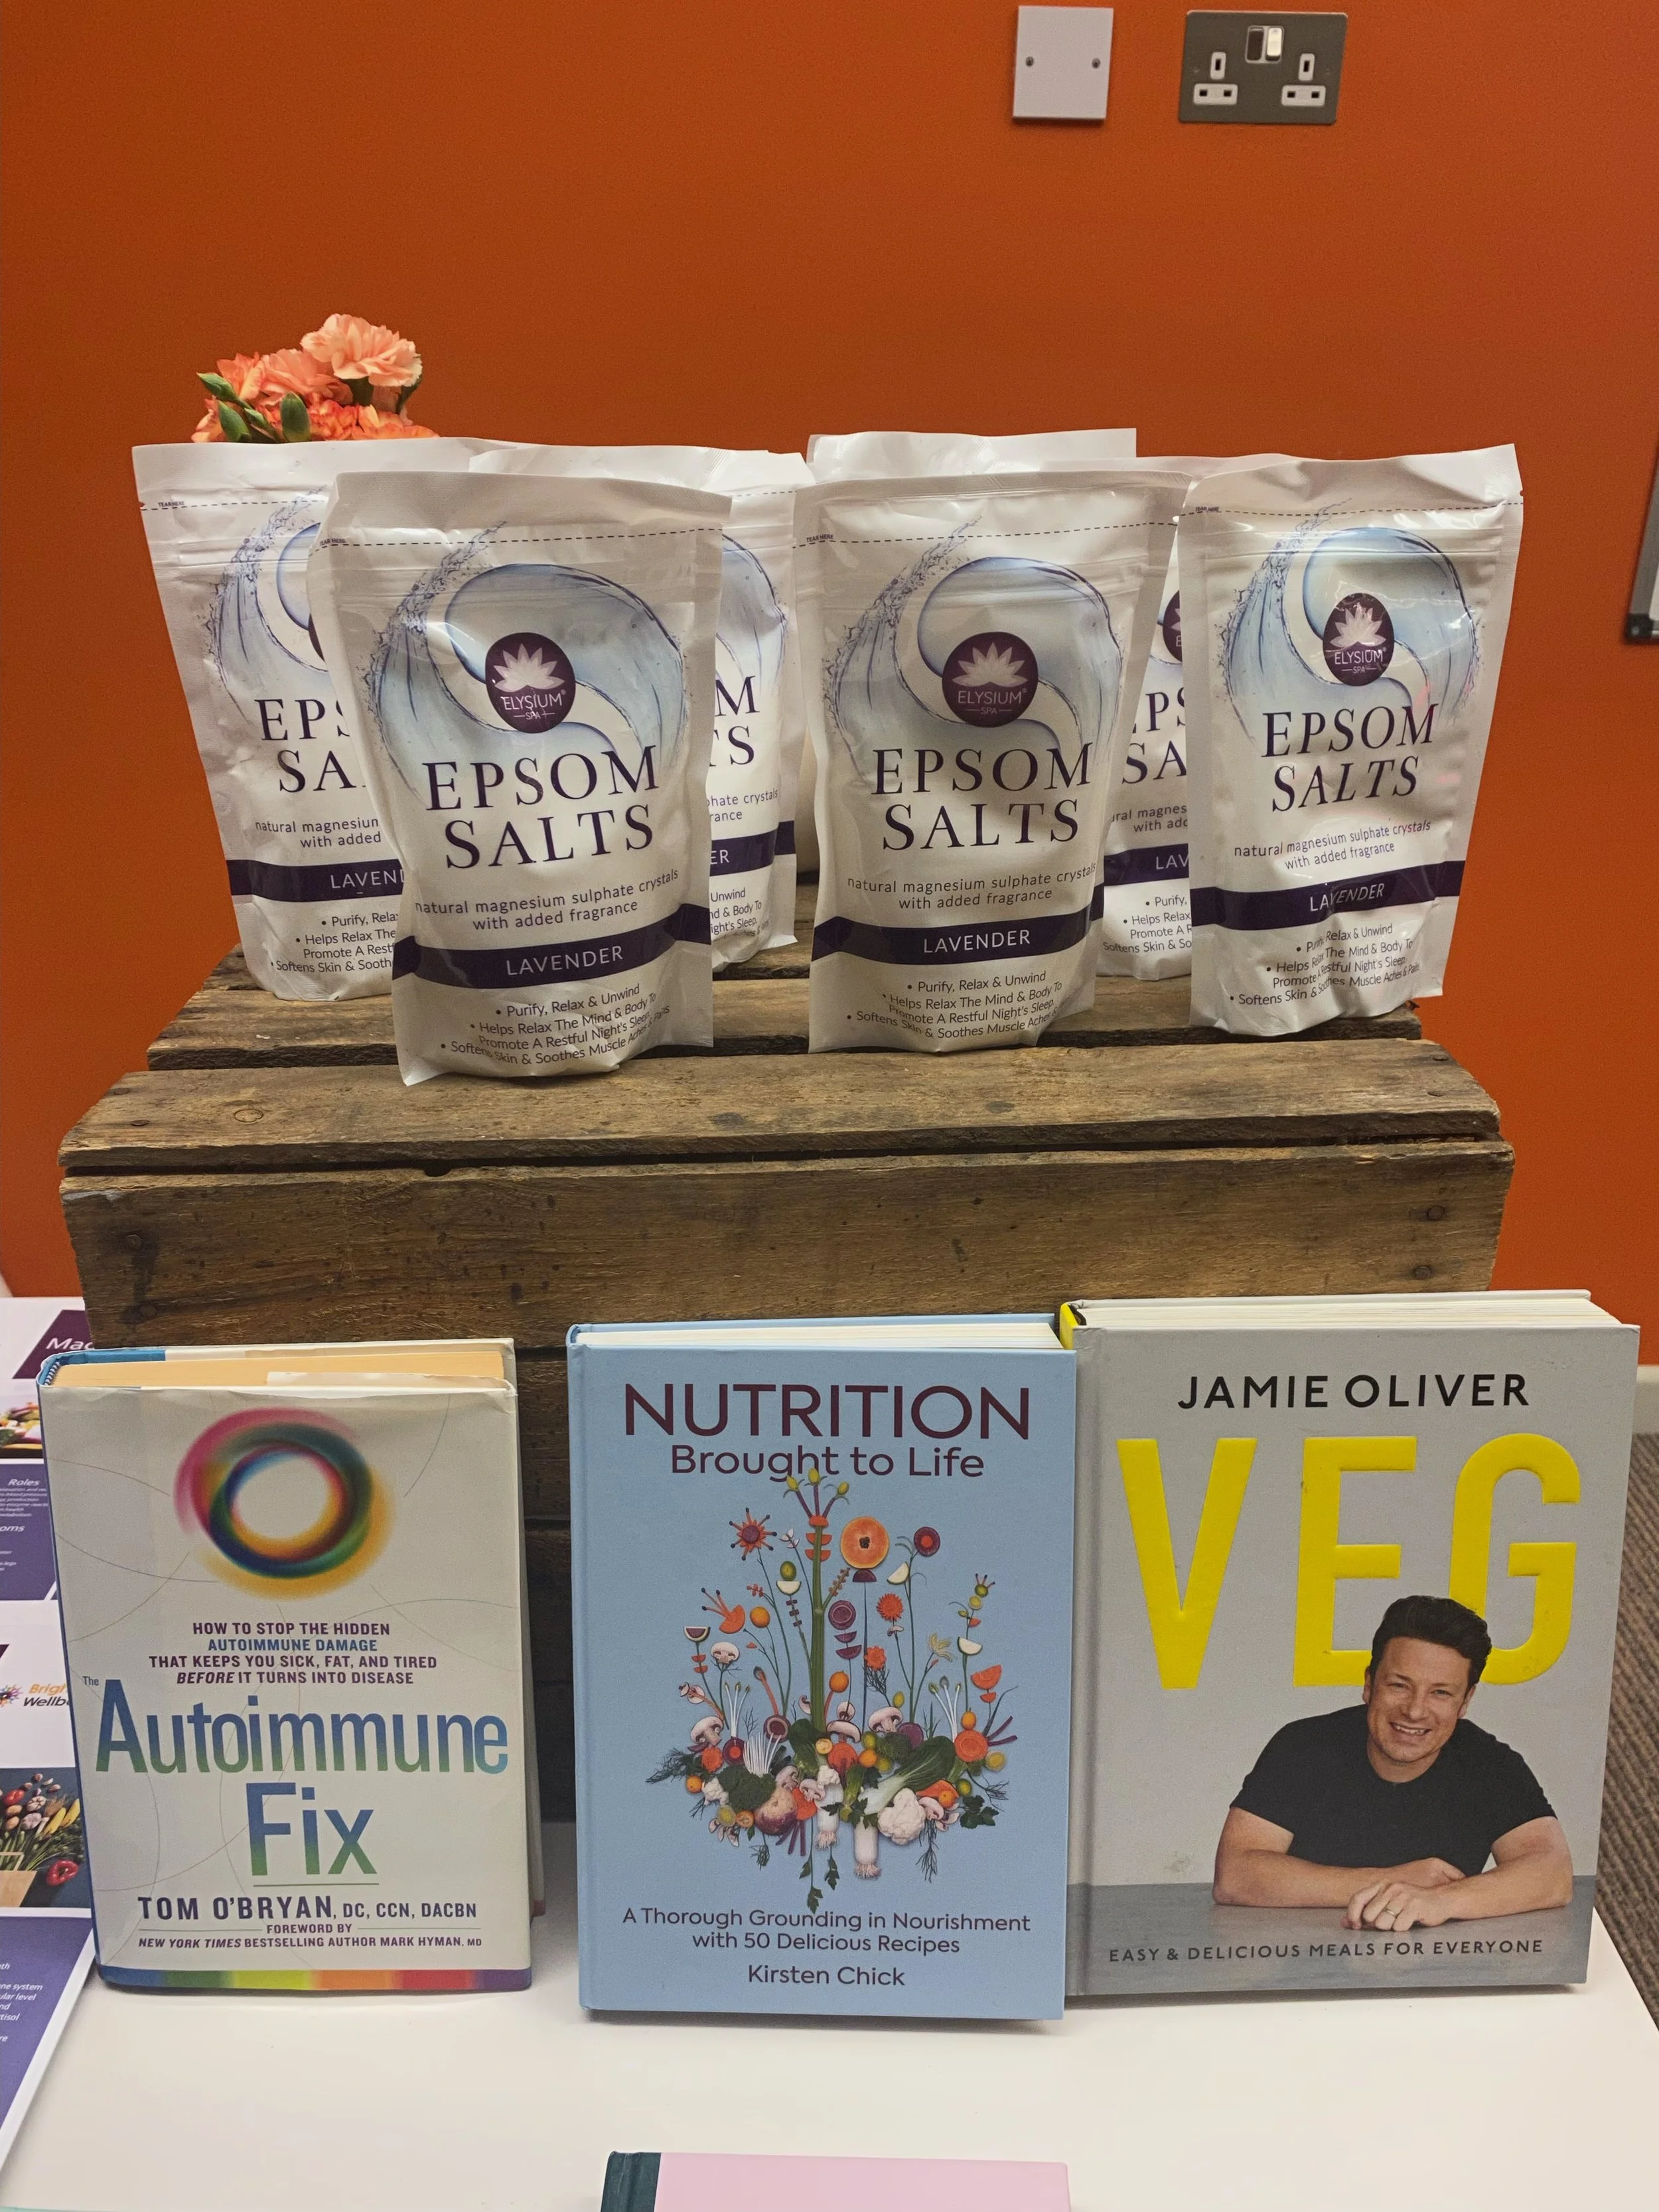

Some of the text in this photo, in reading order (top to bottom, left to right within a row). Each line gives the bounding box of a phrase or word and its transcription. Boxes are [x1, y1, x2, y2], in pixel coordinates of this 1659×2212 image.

[1334, 649, 1384, 665] ELYSIUM
[503, 691, 563, 711] ELYSIUM
[958, 690, 1022, 704] ELYSIUM
[526, 711, 541, 721] SPA
[981, 706, 997, 715] SPA
[1262, 703, 1439, 757] EPSOM
[422, 745, 659, 810] EPSOM
[871, 743, 1093, 794] EPSOM
[744, 789, 778, 804] crystals
[1272, 756, 1419, 812] SALTS
[255, 821, 295, 834] natural
[445, 804, 652, 869] SALTS
[883, 799, 1078, 850] SALTS
[1133, 820, 1161, 832] with
[301, 832, 381, 848] with added
[1234, 820, 1431, 857] natural magnesium sulphate crystals
[1285, 842, 1395, 870] with added fragrance
[847, 862, 1096, 895] natural magnesium sulphate crystals
[415, 868, 678, 915] natural magnesium sulphate crystals
[711, 887, 745, 903] Unwind
[899, 889, 1052, 909] with added fragrance
[1155, 895, 1187, 907] Purify,
[1310, 883, 1385, 912] LAVENDER
[473, 900, 638, 930] with added fragrance
[1131, 913, 1161, 926] Helps
[303, 945, 352, 959] Promote
[924, 929, 1030, 953] LAVENDER
[276, 960, 315, 973] Softens
[506, 945, 623, 976] LAVENDER
[918, 970, 1046, 994] Purify, Relax & Unwind
[507, 984, 640, 1017] Purify, Relax & Unwind
[891, 982, 1062, 1010] Helps Relax The Mind & Body To
[480, 1021, 514, 1037] Helps
[518, 1022, 551, 1035] Relax
[555, 1018, 579, 1031] The
[583, 1009, 611, 1027] Mind
[614, 1007, 622, 1019] &
[624, 998, 648, 1015] Body
[857, 1011, 1050, 1039] Softens Skin & Soothes Muscle Aches
[889, 1004, 934, 1025] Promote
[936, 1014, 946, 1024] A
[949, 1009, 988, 1023] Restful
[992, 1006, 1029, 1022] Night's
[479, 1034, 529, 1051] Promote
[532, 1038, 543, 1049] A
[547, 1031, 588, 1048] Restful
[592, 1021, 628, 1042] Night's
[451, 1041, 492, 1057] Softens
[494, 1048, 518, 1065] Skin
[522, 1053, 532, 1065] &
[536, 1048, 585, 1064] Soothes
[589, 1037, 626, 1057] Muscle
[1178, 1374, 1529, 1409] JAMIE OLIVER
[625, 1382, 1029, 1441] NUTRITION
[672, 1445, 984, 1483] Brought to Life
[1116, 1432, 1581, 1690] VEG
[193, 1622, 390, 1635] HOW TO STOP THE HIDDEN
[208, 1639, 378, 1652] AUTOIMMUNE DAMAGE
[149, 1655, 437, 1669] THAT KEEPS YOU SICK, FAT, AND TIRED
[82, 1676, 99, 1686] The
[177, 1672, 413, 1684] BEFORE IT TURNS INTO DISEASE
[96, 1679, 508, 1775] Autoimmune
[246, 1782, 378, 1876] Fix
[138, 1895, 476, 1920] TOM O'BRYAN, DC, CCN, DACBN
[622, 1907, 1032, 1932] A Thorough Grounding in Nourishment
[267, 1923, 352, 1934] FOREWORD BY
[139, 1938, 165, 1948] NEW
[169, 1938, 200, 1949] YORK
[205, 1938, 241, 1949] TIMES
[244, 1937, 325, 1948] BESTSELLING
[328, 1937, 376, 1947] AUTHOR
[380, 1937, 415, 1947] MARK
[418, 1937, 464, 1947] HYMAN,
[692, 1931, 961, 1956] with 50 Delicious Recipes
[1109, 1939, 1544, 1963] EASY & DELICIOUS MEALS FOR EVERYONE
[748, 1964, 906, 1986] Kirsten Chick
